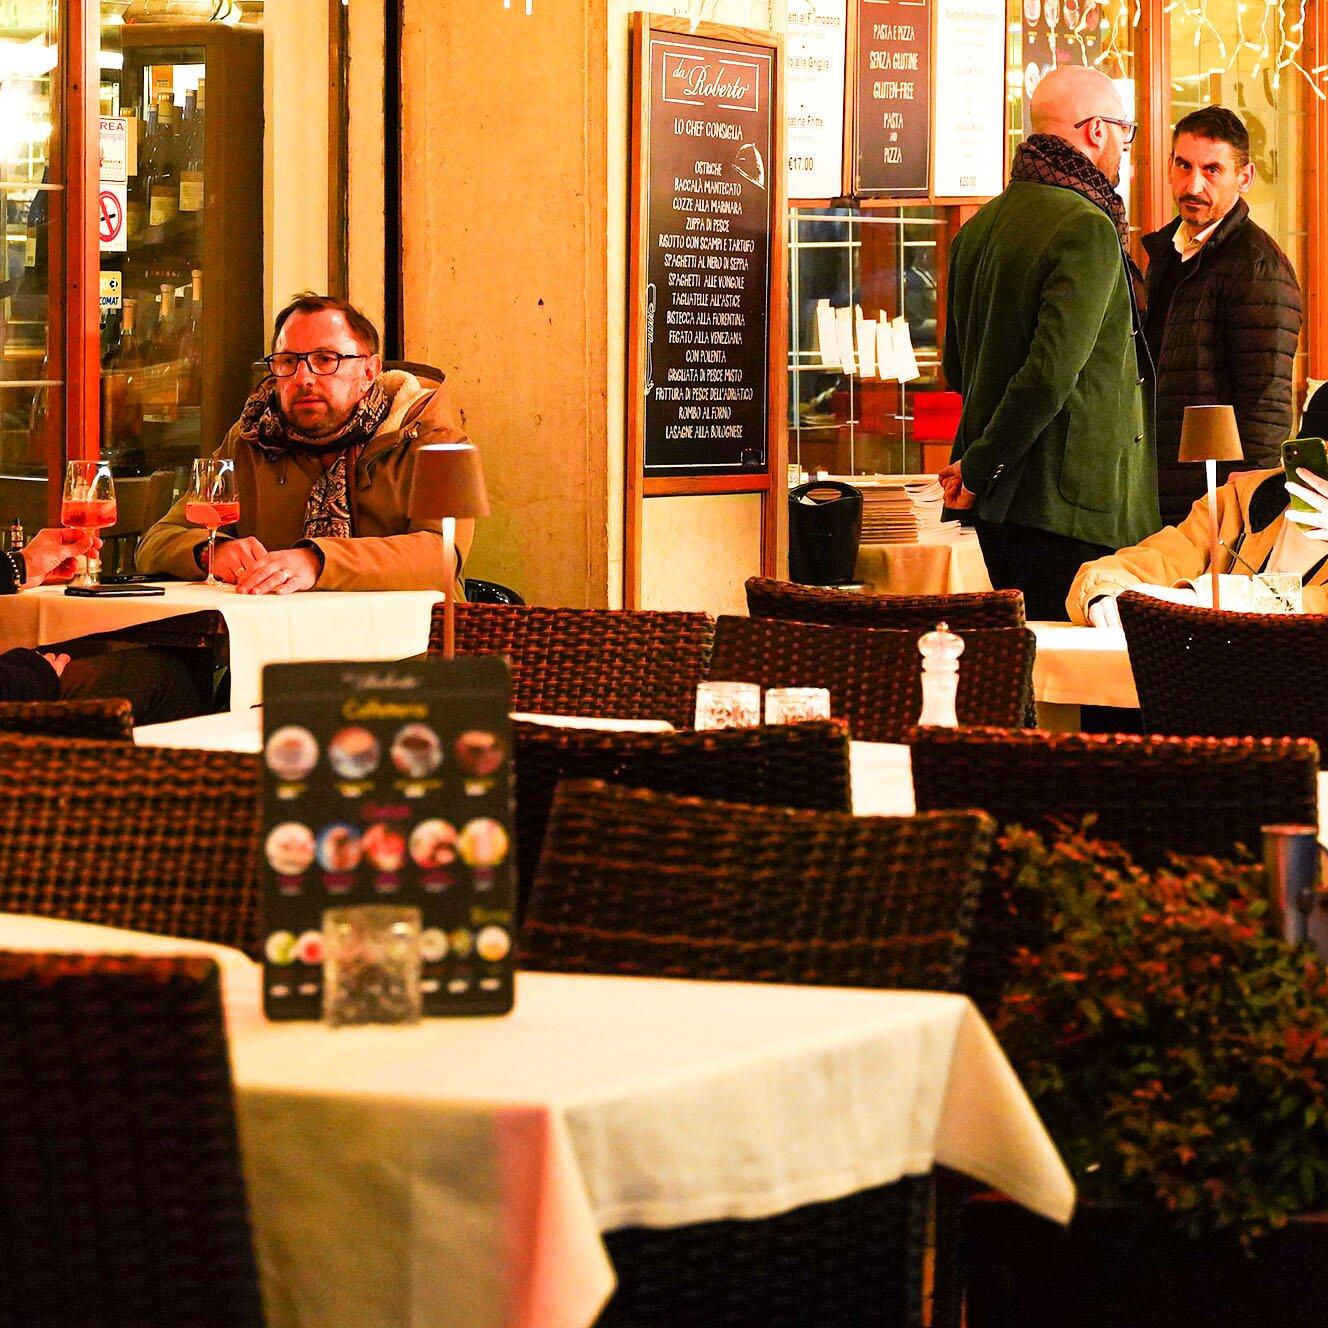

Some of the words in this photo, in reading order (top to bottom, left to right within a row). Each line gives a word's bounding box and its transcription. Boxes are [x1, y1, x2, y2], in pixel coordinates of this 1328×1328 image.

[873, 23, 893, 41] PASTA
[898, 24, 916, 42] PIZZA
[869, 50, 892, 70] SENZA
[892, 52, 919, 71] GLUTINE
[672, 58, 690, 79] da
[683, 65, 750, 100] Roberto
[873, 80, 915, 100] GLUTEN-FREE
[883, 112, 904, 129] PASTA
[674, 118, 684, 135] LO
[686, 119, 705, 137] CHEF
[706, 122, 743, 141] CONSIGLIA
[788, 156, 814, 171] €17.00
[883, 146, 903, 164] PIZZA
[694, 161, 723, 176] OSTRICHE
[674, 177, 703, 193] BACCALÀ
[704, 182, 742, 196] MANTECATO
[673, 197, 693, 212] COZZE
[694, 198, 710, 213] ALLA
[711, 199, 743, 215] MARINARA
[686, 217, 705, 231] ZUPPA
[713, 219, 730, 233] PESCE
[659, 233, 684, 249] RISOTTO
[685, 235, 699, 249] CON
[700, 236, 723, 251] SCAMPI
[729, 238, 755, 253] TARTUFO
[664, 253, 697, 268] SPAGHETTI
[698, 255, 706, 269] AL
[706, 255, 723, 270] NERO
[730, 257, 749, 271] SEPPIA
[668, 272, 701, 287] SPAGHETTI
[703, 274, 718, 289] ALLE
[718, 275, 745, 290] VONGOLE
[672, 292, 709, 307] TAGLIATELLE
[709, 294, 741, 308] ALL'ASTICE
[666, 310, 695, 326] BISTECCA
[696, 312, 712, 326] ALLA
[712, 312, 746, 327] FIORENTINA
[668, 330, 693, 344] FEGATO
[694, 331, 710, 344] ALLA
[710, 331, 743, 345] VENEZIANA
[685, 349, 699, 363] CON
[700, 350, 727, 363] POLENTA
[667, 368, 699, 382] GRIGLIATA
[706, 369, 723, 382] PESCE
[724, 369, 743, 382] MISTO
[655, 387, 684, 401] FRITTURA
[692, 388, 709, 401] PESCE
[710, 387, 754, 401] DELL'ADRIATICO
[678, 406, 702, 420] ROMBO
[702, 407, 710, 420] AL
[711, 407, 732, 420] FORNO
[665, 425, 693, 439] LASAGNE
[694, 425, 710, 439] ALLA
[710, 425, 743, 439] BOLOGNESE
